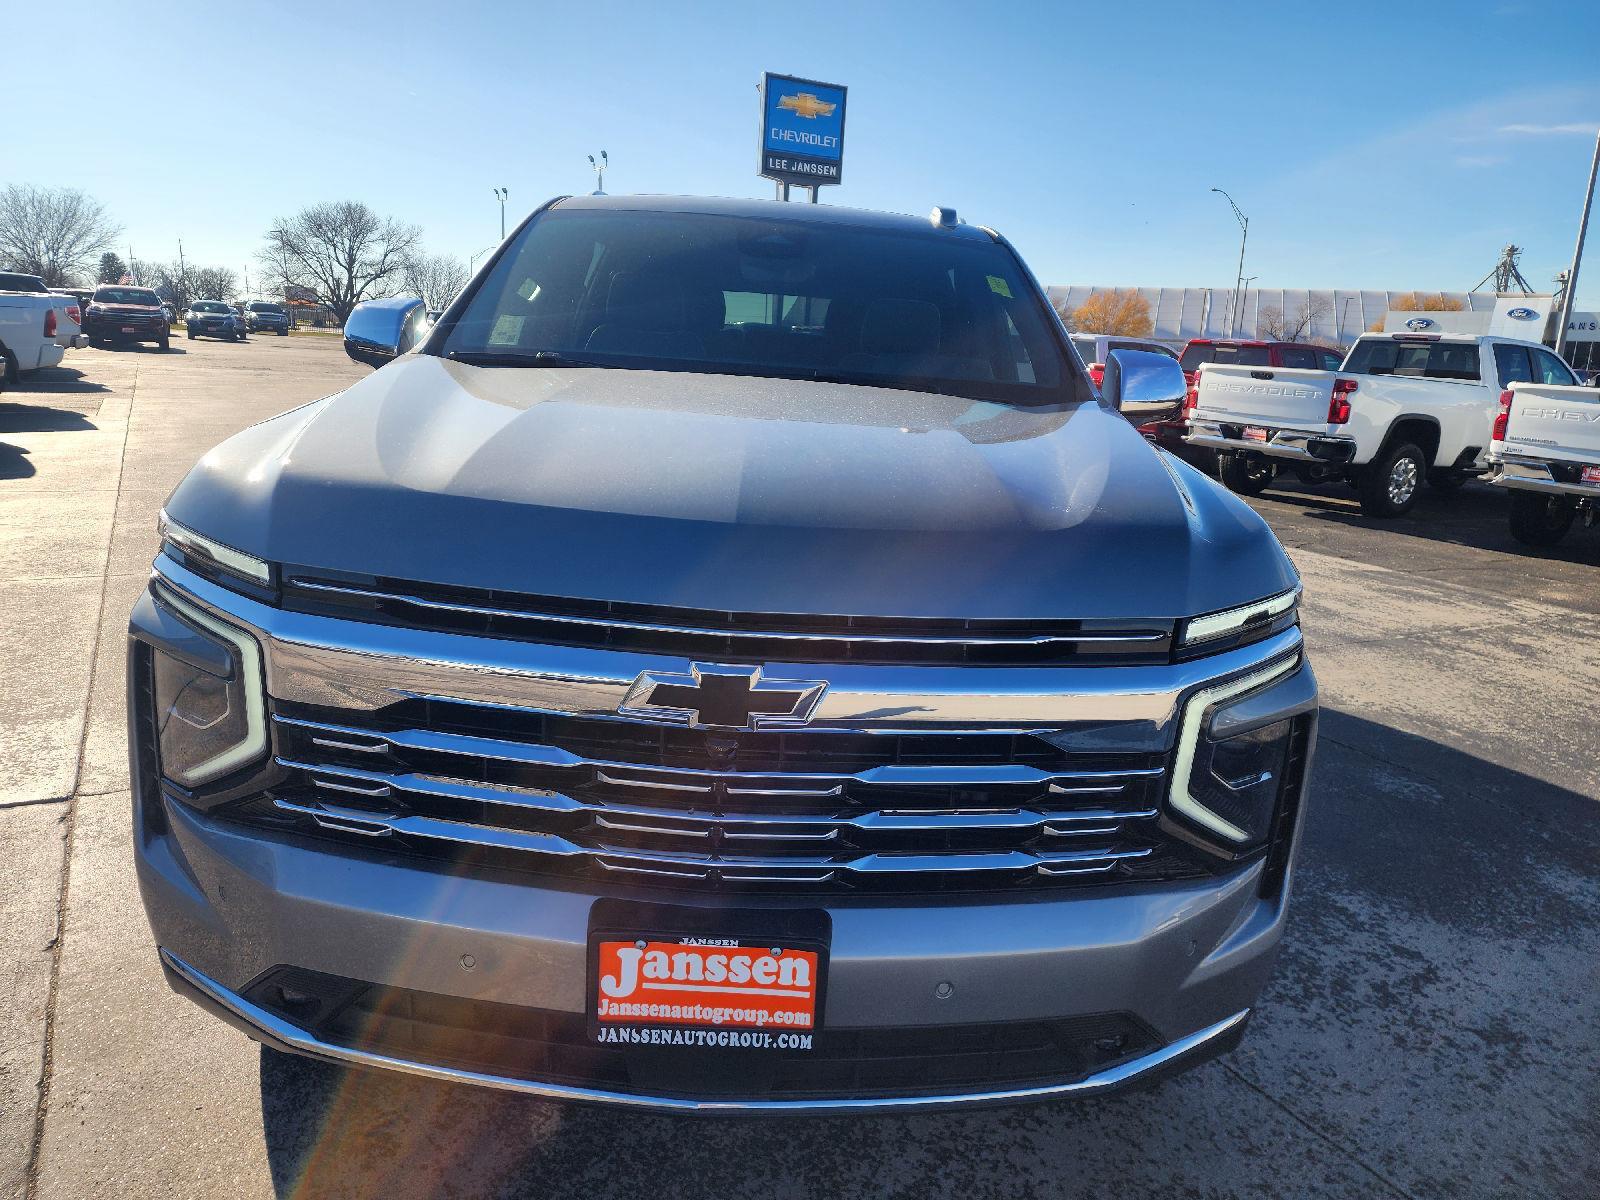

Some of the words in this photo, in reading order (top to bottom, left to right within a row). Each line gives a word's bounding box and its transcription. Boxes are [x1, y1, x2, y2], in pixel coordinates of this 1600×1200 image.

[771, 127, 838, 148] CHEVROLET
[769, 158, 788, 169] LEE
[791, 161, 837, 176] JANSSEN
[1567, 322, 1600, 331] ANS
[1206, 382, 1323, 399] CHEVROLET
[678, 937, 739, 947] JANSSEN
[600, 947, 811, 998] Janssen
[597, 999, 811, 1026] Janssenautogroup.com
[597, 1027, 813, 1050] JANSSENAUTOGROUP.COM
